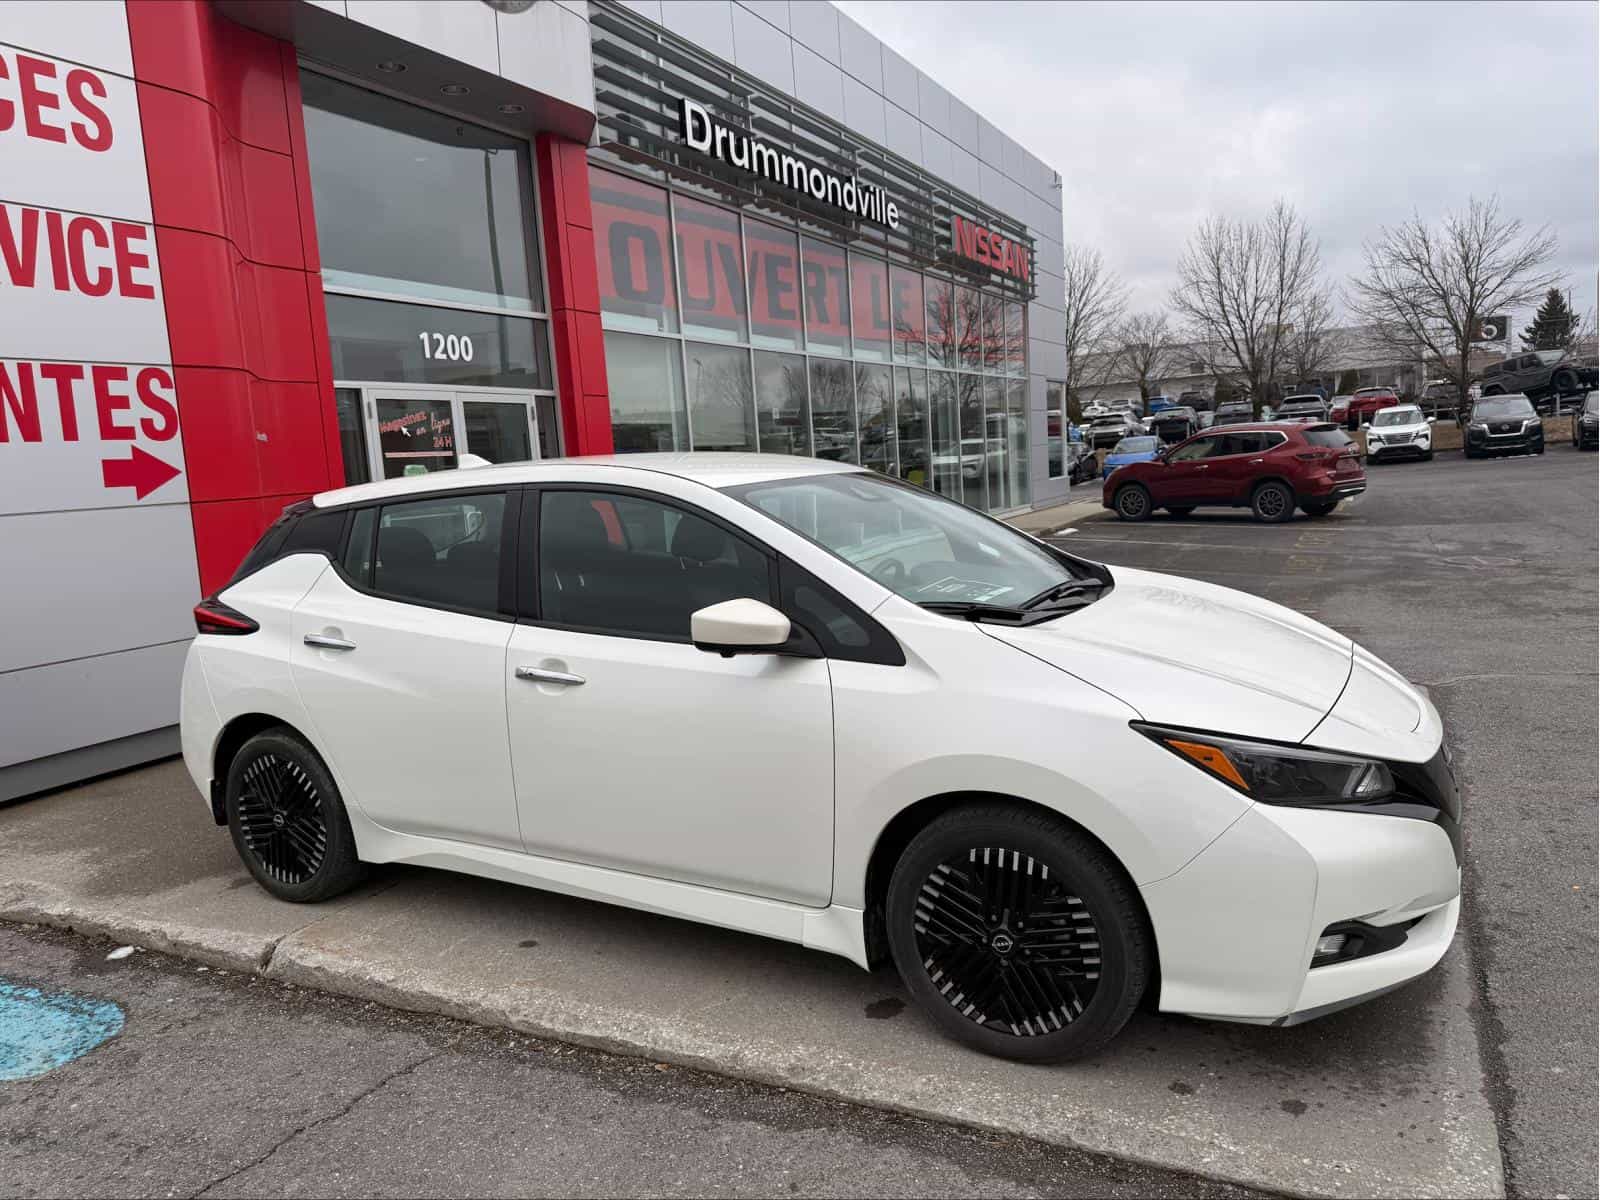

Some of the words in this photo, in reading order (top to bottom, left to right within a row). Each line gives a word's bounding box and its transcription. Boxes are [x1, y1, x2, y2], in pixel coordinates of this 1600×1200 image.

[682, 98, 900, 230] Drummondville
[608, 220, 849, 327] OUVERT
[871, 272, 913, 331] LE
[952, 214, 1029, 282] NISSAN
[419, 331, 473, 362] 1200
[0, 361, 180, 443] NTES
